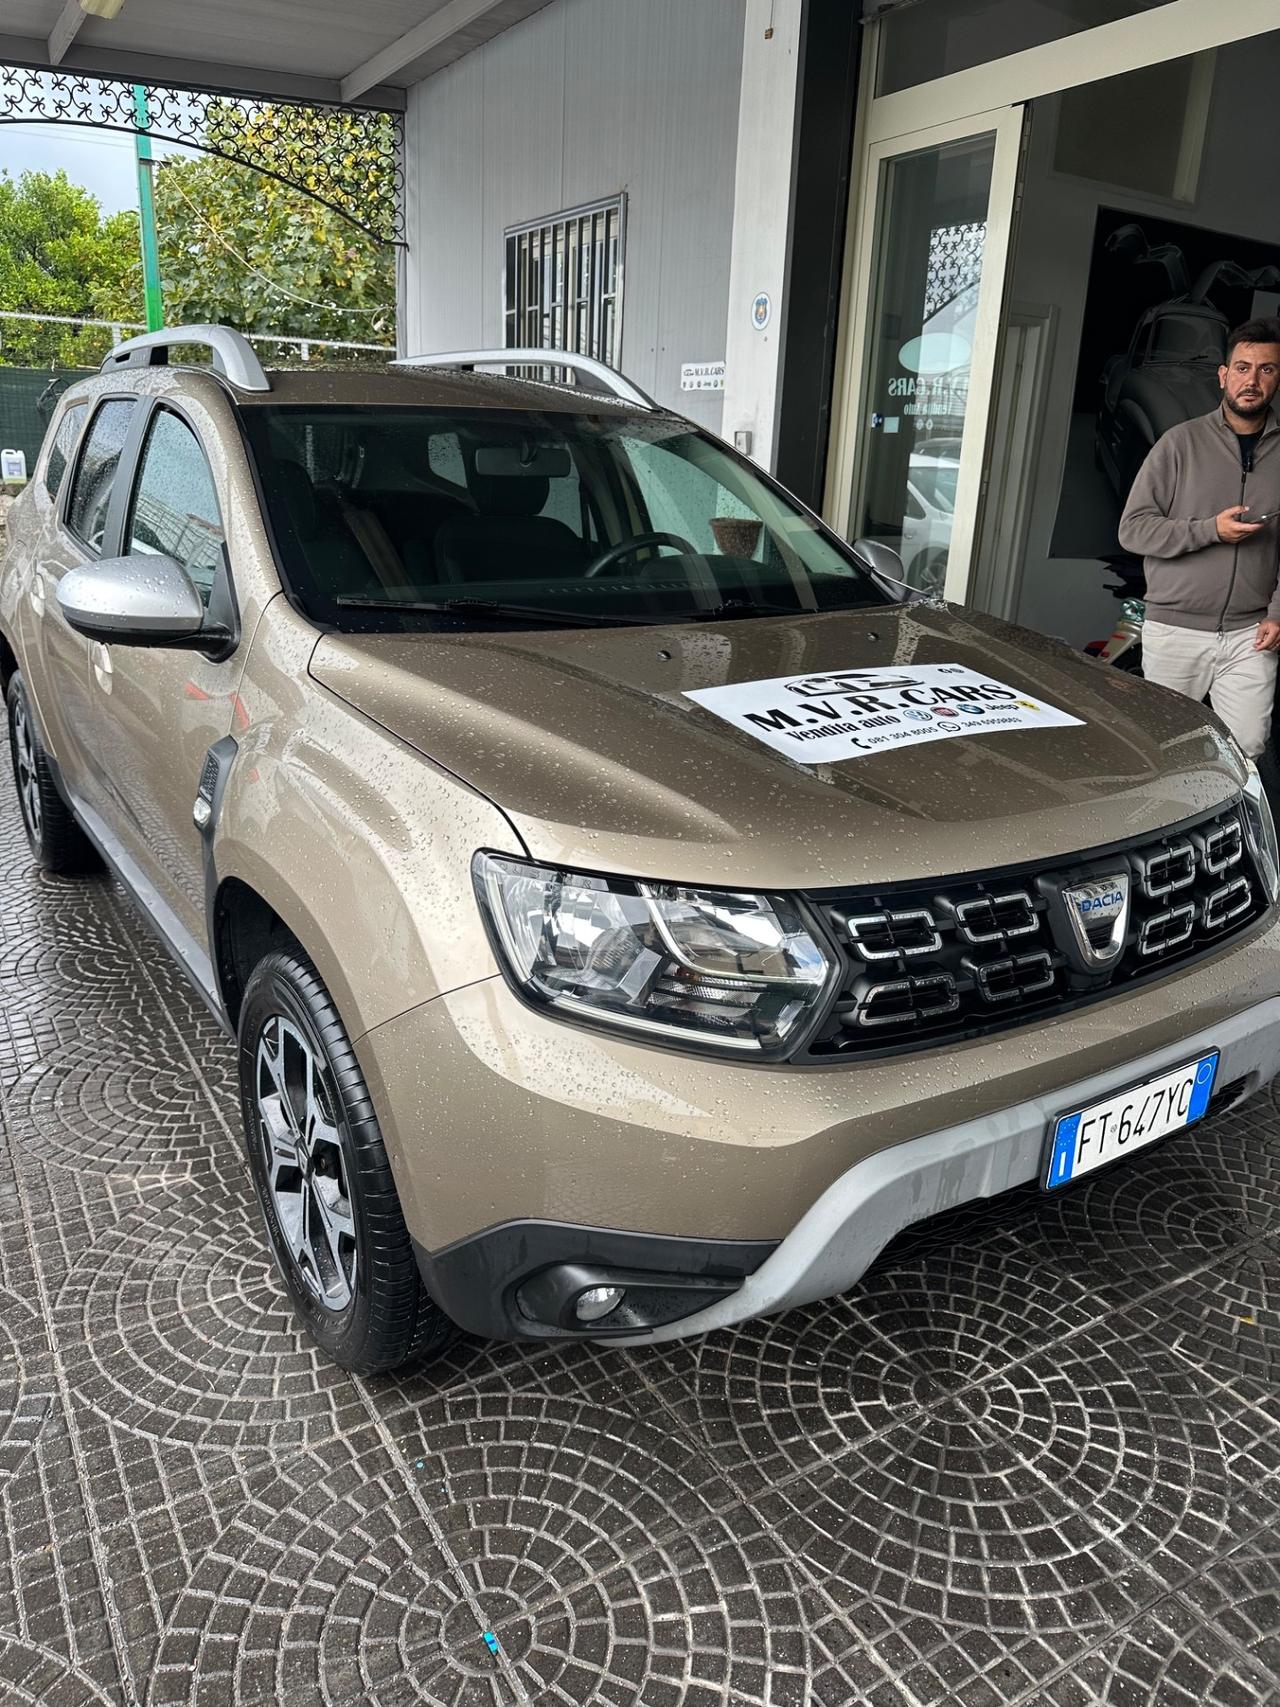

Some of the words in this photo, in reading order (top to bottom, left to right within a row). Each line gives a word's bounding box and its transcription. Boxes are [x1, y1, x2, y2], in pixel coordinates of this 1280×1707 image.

[785, 721, 861, 742] Vendita
[858, 714, 901, 729] auto
[867, 735, 890, 745] 081
[1081, 891, 1124, 912] DACIA
